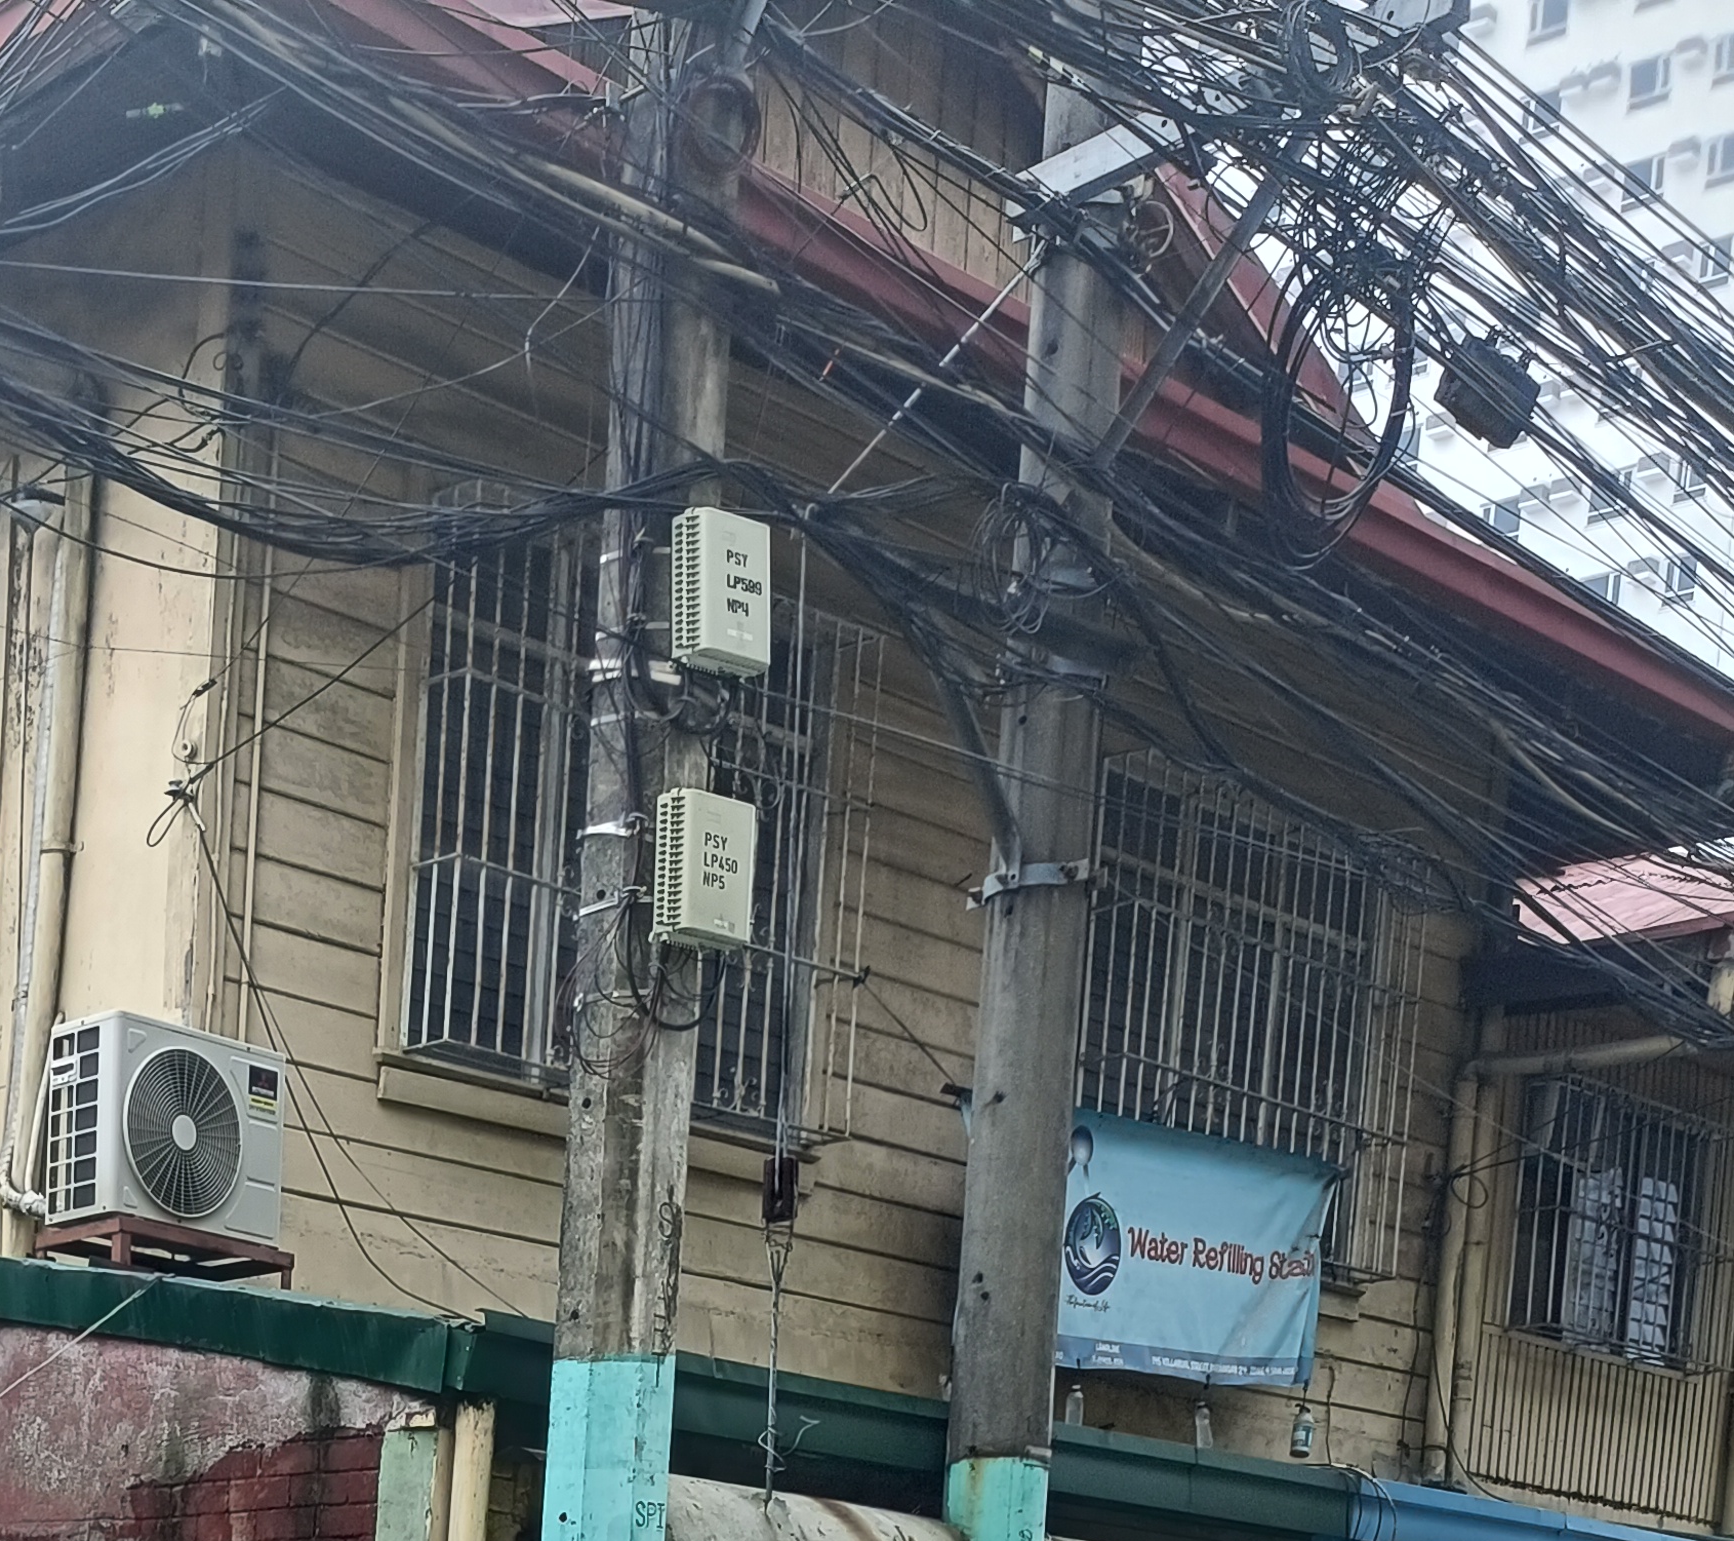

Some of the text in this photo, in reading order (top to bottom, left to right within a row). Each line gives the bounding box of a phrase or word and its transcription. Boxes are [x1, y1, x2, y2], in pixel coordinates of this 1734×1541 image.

[727, 549, 748, 568] PSY
[727, 598, 749, 617] NP4
[704, 831, 728, 851] PSY
[704, 851, 738, 874] LP450
[702, 870, 726, 890] NP5
[1127, 1226, 1188, 1266] Water
[1192, 1237, 1265, 1285] Refilling
[635, 1500, 666, 1530] SPI
